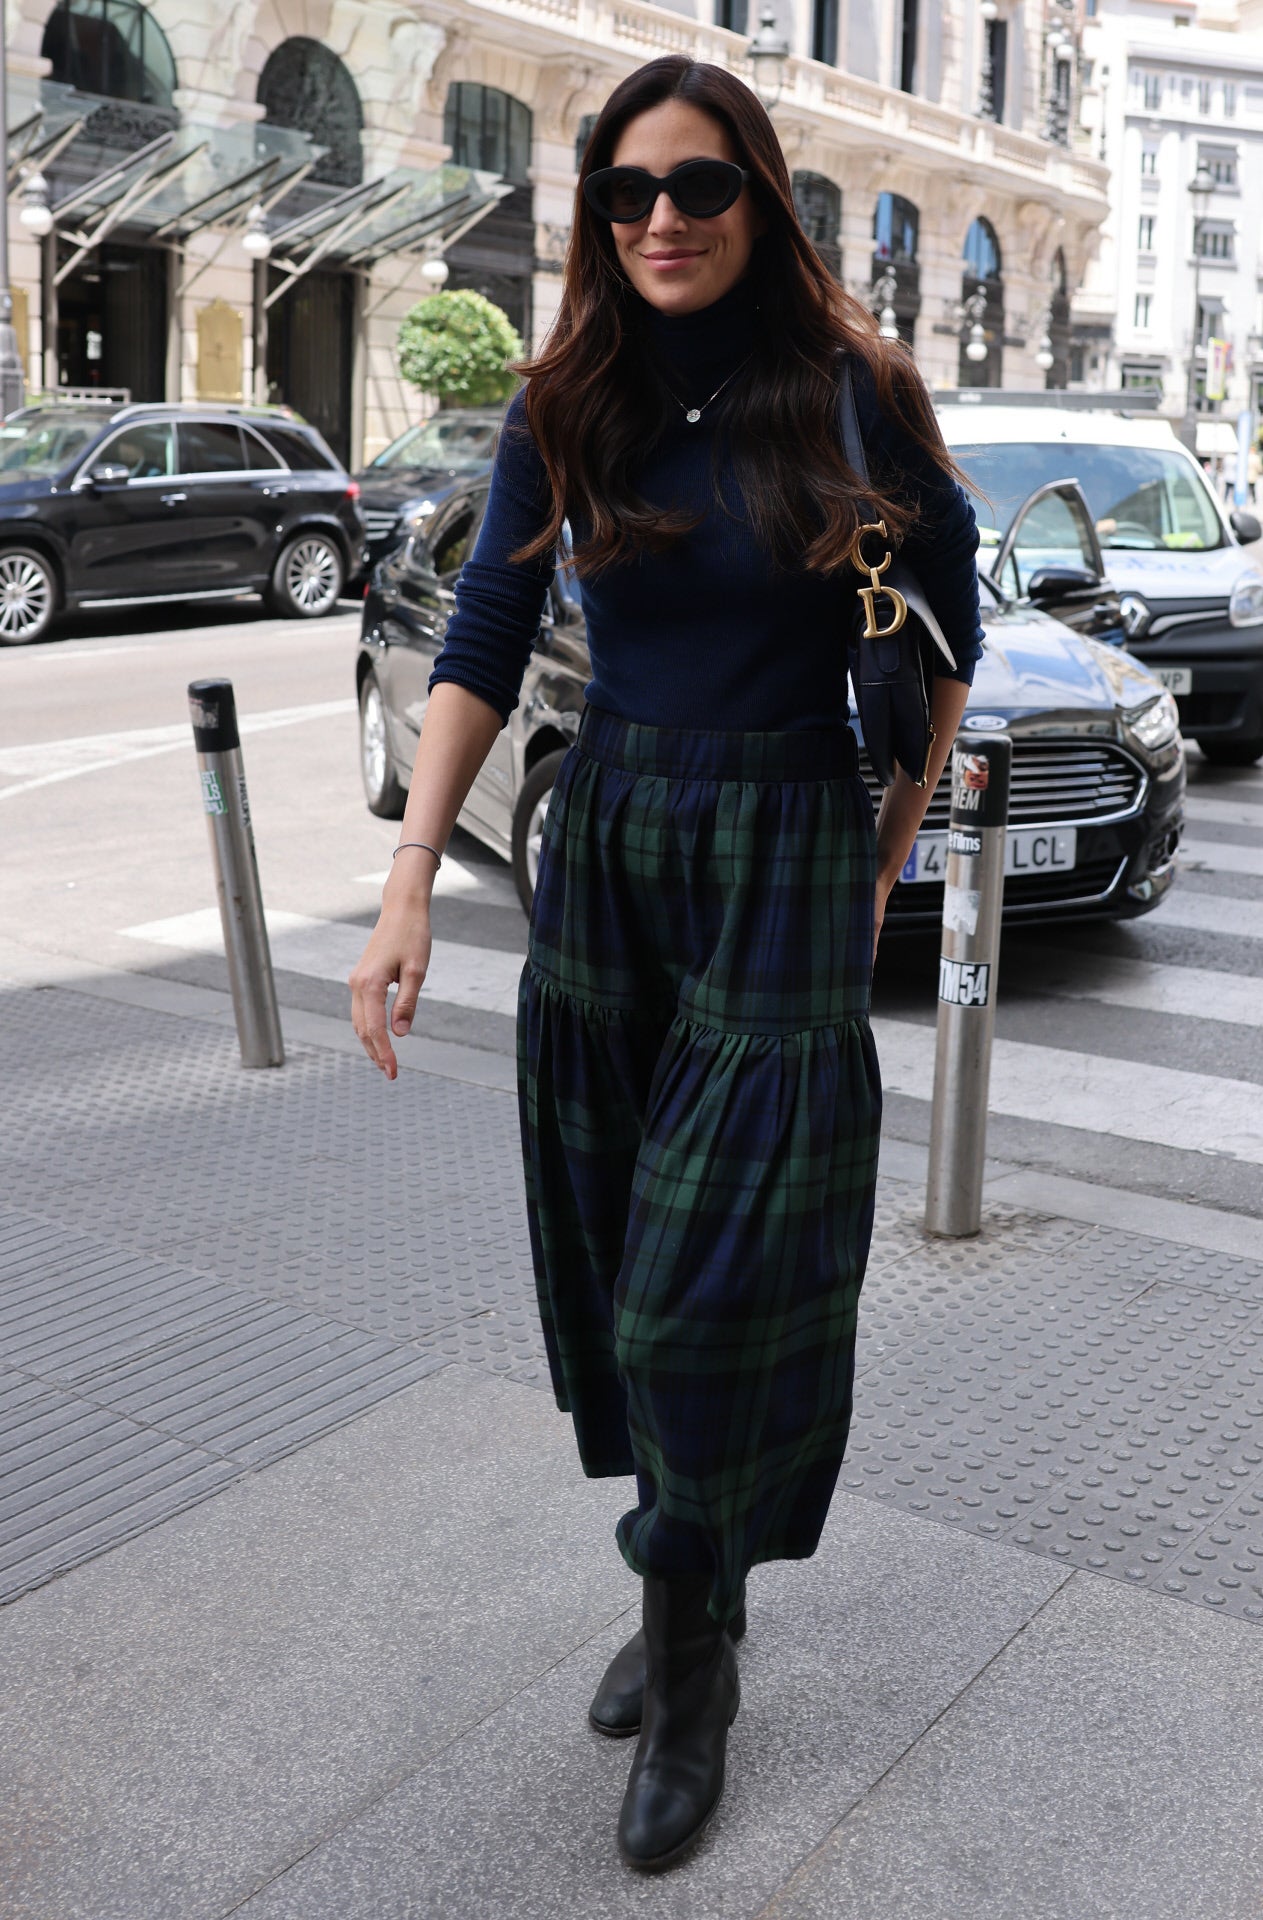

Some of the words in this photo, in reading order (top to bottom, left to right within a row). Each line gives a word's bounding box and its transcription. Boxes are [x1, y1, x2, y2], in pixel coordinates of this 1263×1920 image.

[850, 520, 892, 576] C
[857, 586, 908, 639] D
[1012, 836, 1066, 869] LCL
